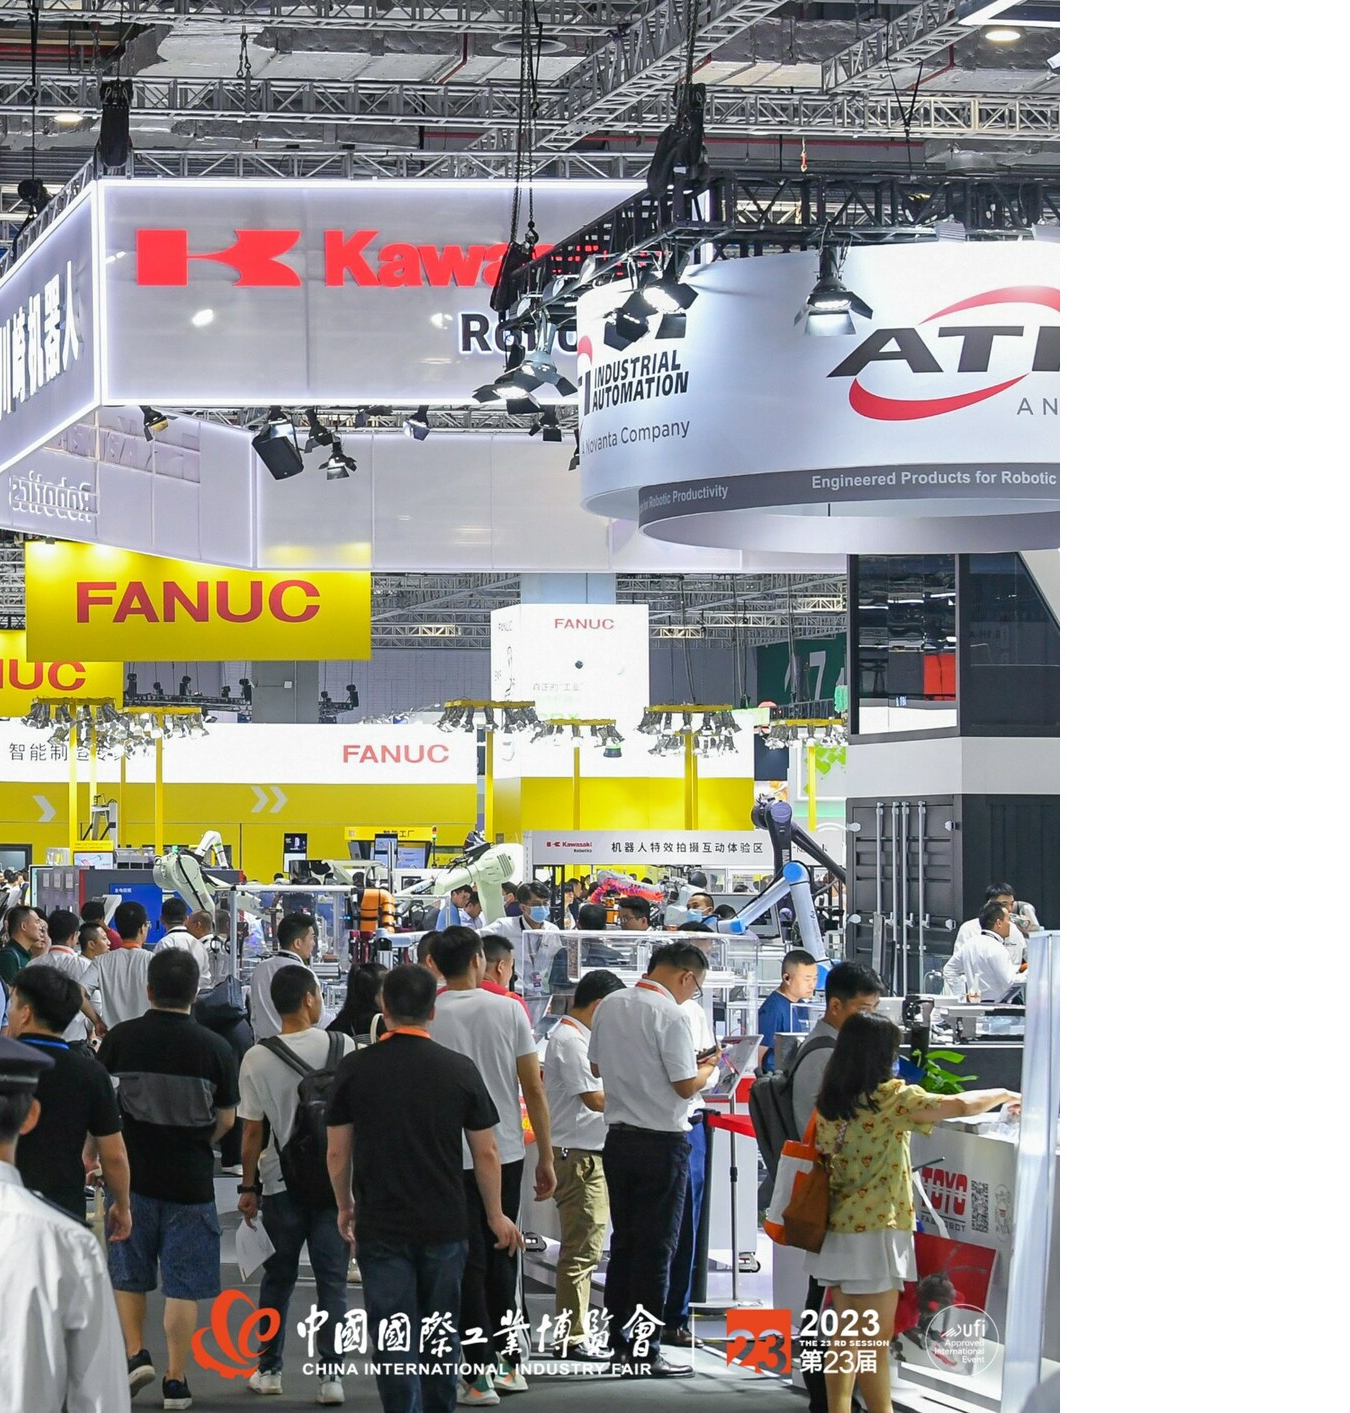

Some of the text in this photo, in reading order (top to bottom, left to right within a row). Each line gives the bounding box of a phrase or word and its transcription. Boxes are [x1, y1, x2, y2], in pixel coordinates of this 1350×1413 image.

[594, 350, 681, 388] INDUSTRIAL
[592, 371, 689, 412] AUTOMATION
[620, 420, 690, 444] Company
[811, 471, 1057, 490] Engineered Products for Robotic
[672, 485, 729, 503] Productivity
[76, 579, 321, 624] FANUC
[554, 618, 615, 630] FANUC
[342, 743, 450, 764] FANUC
[611, 842, 764, 854] 机器人特效拍摄互动体验区
[921, 1166, 968, 1216] TOYO
